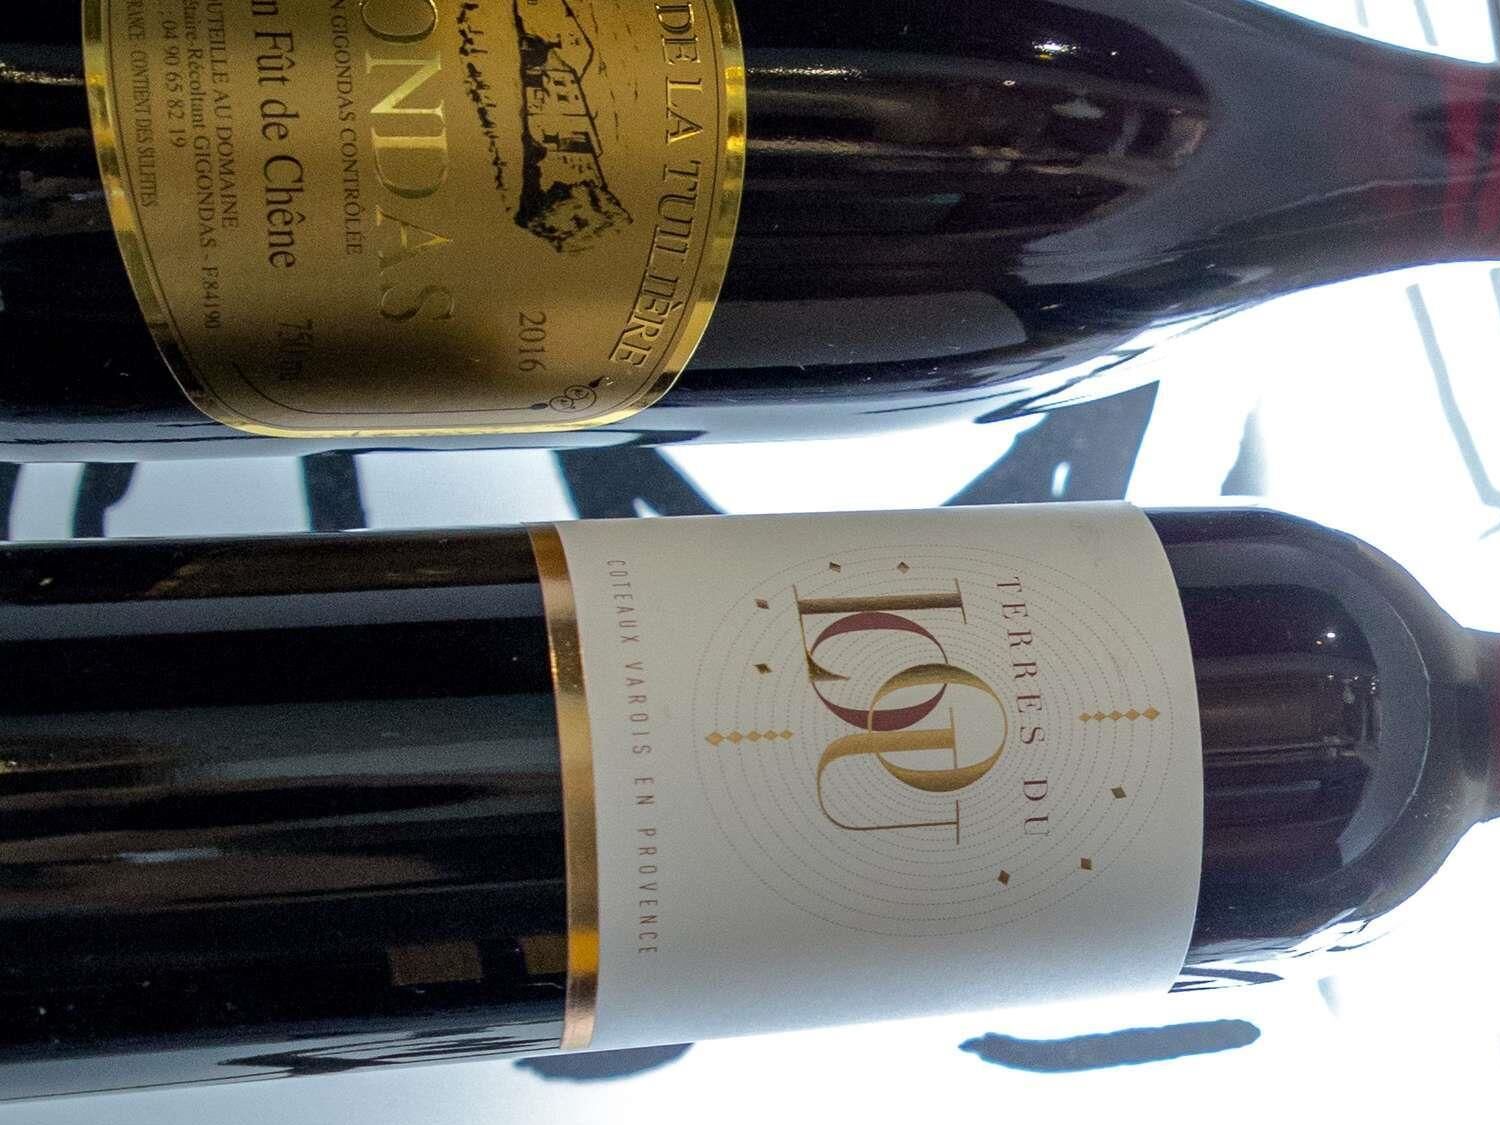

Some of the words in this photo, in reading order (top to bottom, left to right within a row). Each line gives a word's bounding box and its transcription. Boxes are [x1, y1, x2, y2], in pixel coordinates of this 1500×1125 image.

[128, 0, 145, 40] RANCE
[162, 20, 178, 40] 04
[206, 0, 230, 84] UTEILLE
[656, 2, 700, 65] DE
[130, 51, 150, 114] CONTIENT
[163, 47, 179, 66] 90
[166, 72, 183, 93] 65
[255, 31, 295, 87] Fût
[331, 15, 355, 122] GIGONDAS
[135, 119, 153, 143] DES
[167, 100, 185, 120] 82
[213, 89, 233, 121] AU
[260, 99, 299, 141] de
[665, 76, 703, 145] LA
[169, 128, 187, 148] 19
[137, 146, 159, 208] SULFITES
[194, 135, 217, 248] GIGONDAS
[217, 127, 239, 228] DOMAINE
[341, 128, 366, 256] CONTRÔLÉE
[263, 155, 306, 268] Chêne
[609, 160, 700, 368] TUILIÈRE
[517, 311, 546, 372] 2016
[607, 559, 640, 644] COTEAUX
[625, 660, 651, 755] VAROIS
[995, 575, 1045, 745] TERRES
[1023, 778, 1051, 837] DU
[634, 776, 655, 806] EN
[638, 827, 658, 954] PROVENCE
